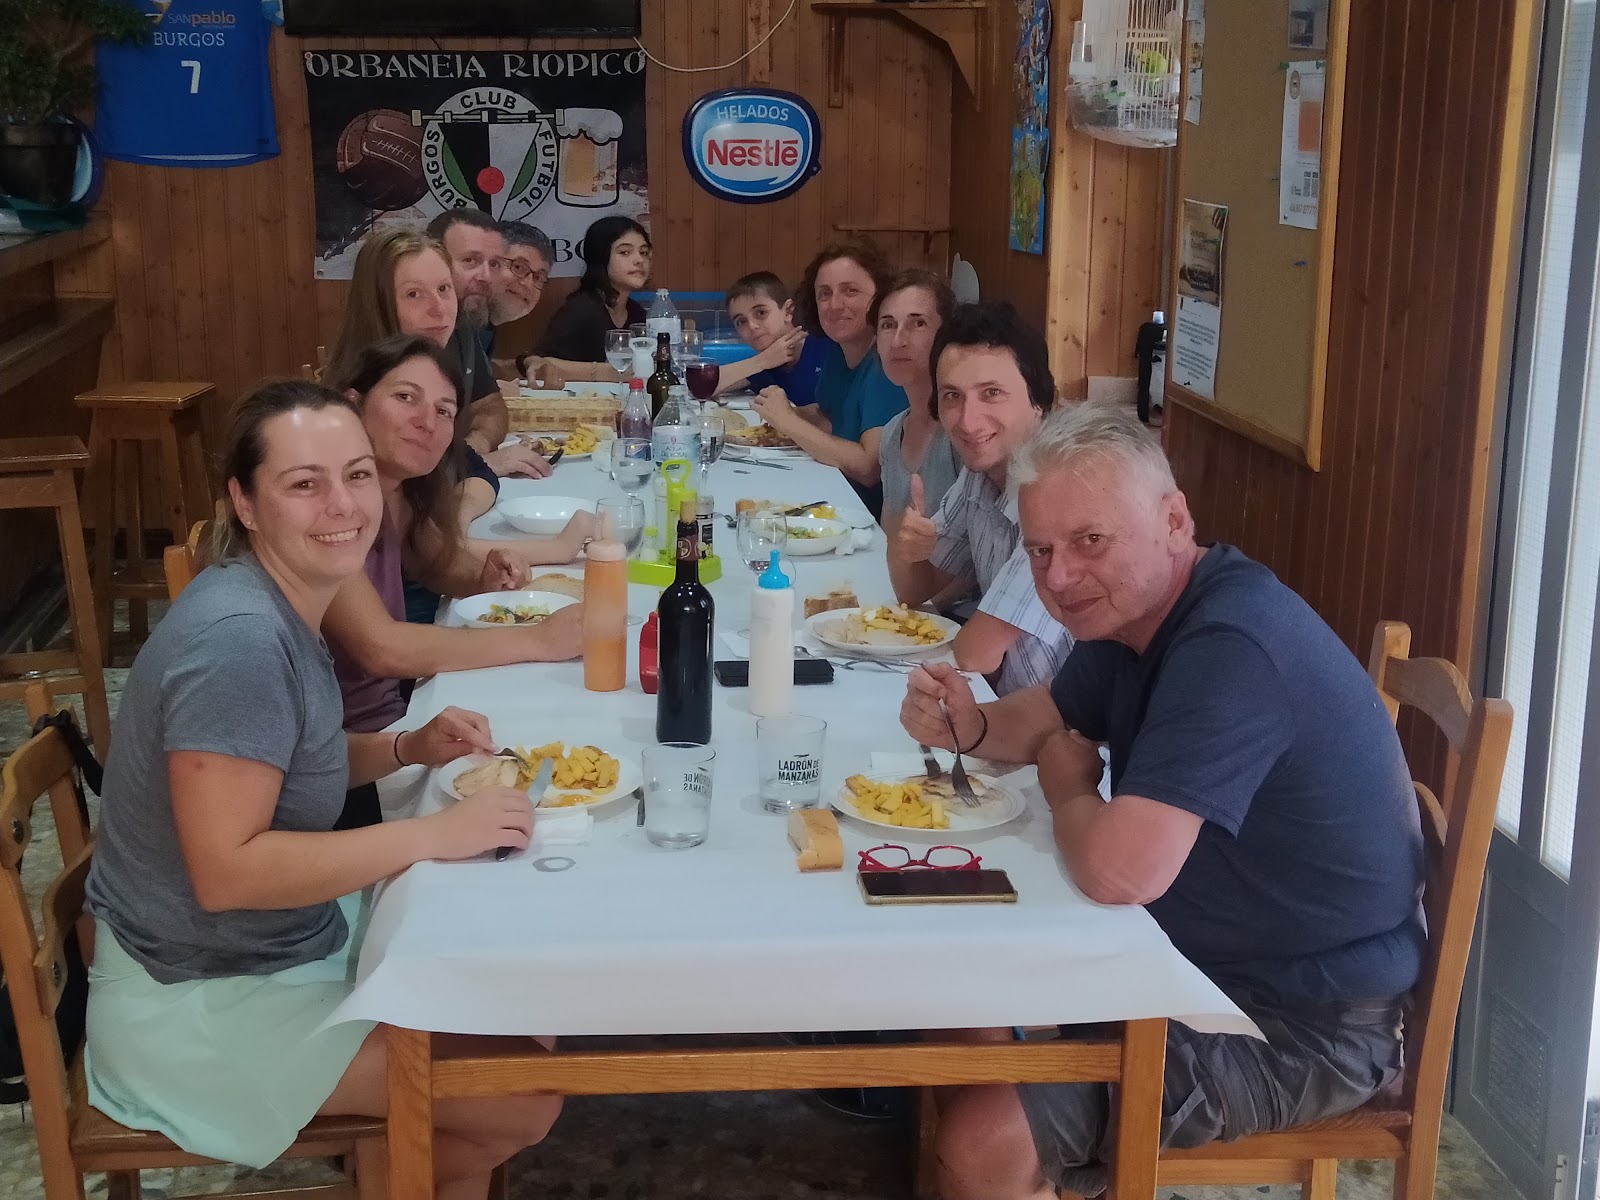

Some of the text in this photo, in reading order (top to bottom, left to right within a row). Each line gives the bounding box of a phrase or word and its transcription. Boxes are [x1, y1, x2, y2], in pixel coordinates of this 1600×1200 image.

[154, 33, 225, 47] BURGOS
[306, 51, 646, 78] ORBANEJA RIOPICO
[181, 60, 201, 94] 7
[460, 91, 516, 109] CLUB
[716, 104, 789, 121] HELADOS
[708, 139, 798, 166] Nestlé
[518, 130, 555, 207] FUTBOL
[778, 759, 819, 771] LADRÓN DE
[778, 769, 818, 781] MANZANAS
